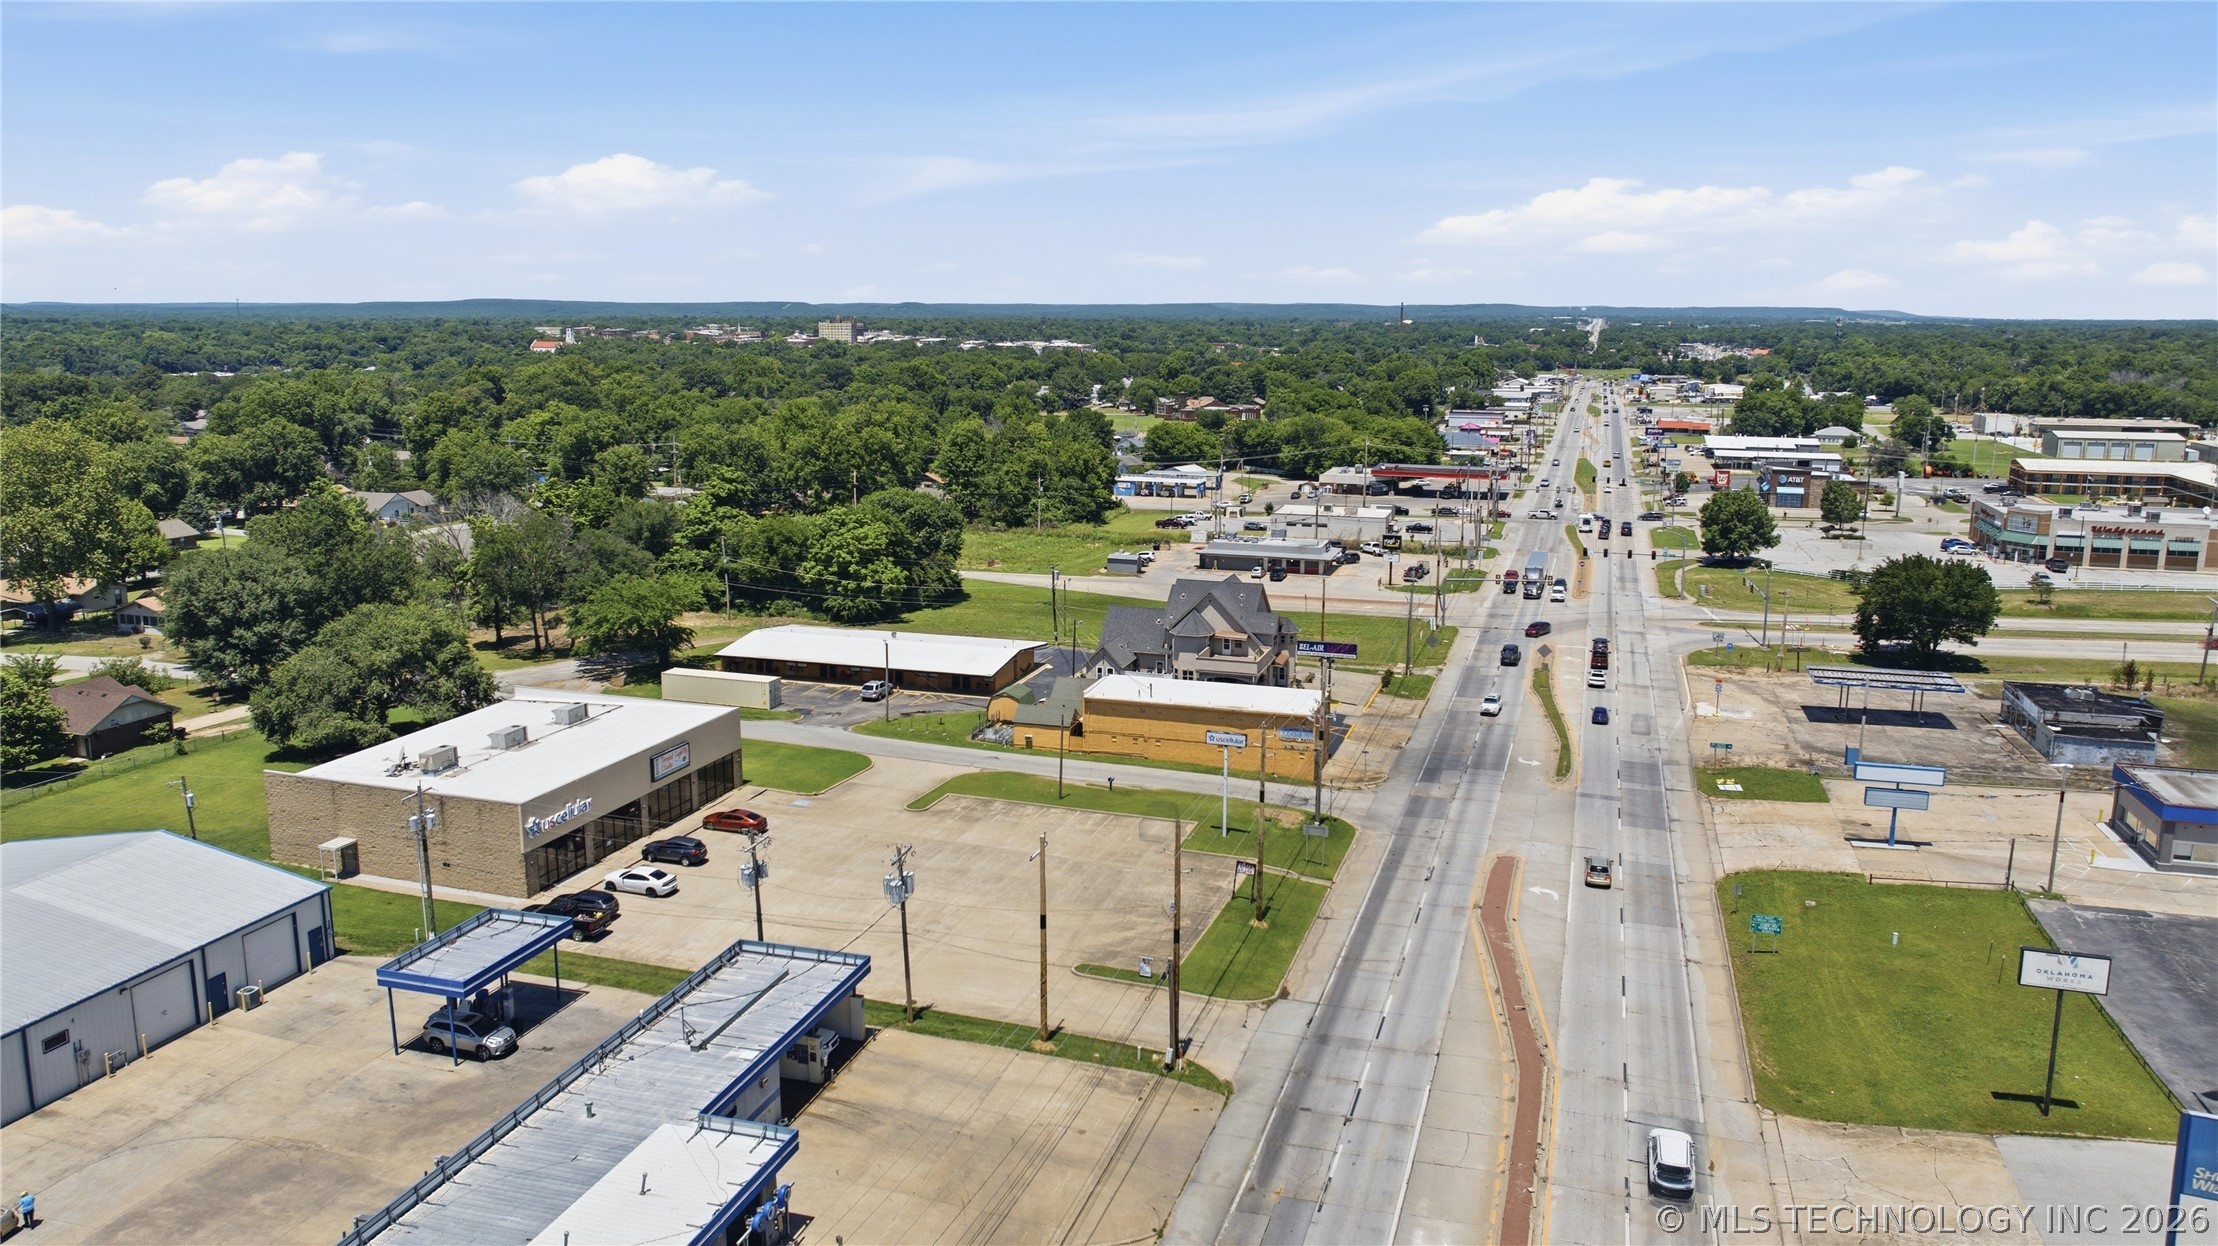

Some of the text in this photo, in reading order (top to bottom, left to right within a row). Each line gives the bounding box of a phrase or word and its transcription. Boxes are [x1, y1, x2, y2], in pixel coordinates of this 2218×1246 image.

[2091, 525, 2165, 535] Walgreens
[541, 797, 592, 832] uscellular
[2035, 968, 2093, 980] OKLAHOMA
[2046, 976, 2082, 984] WORKS
